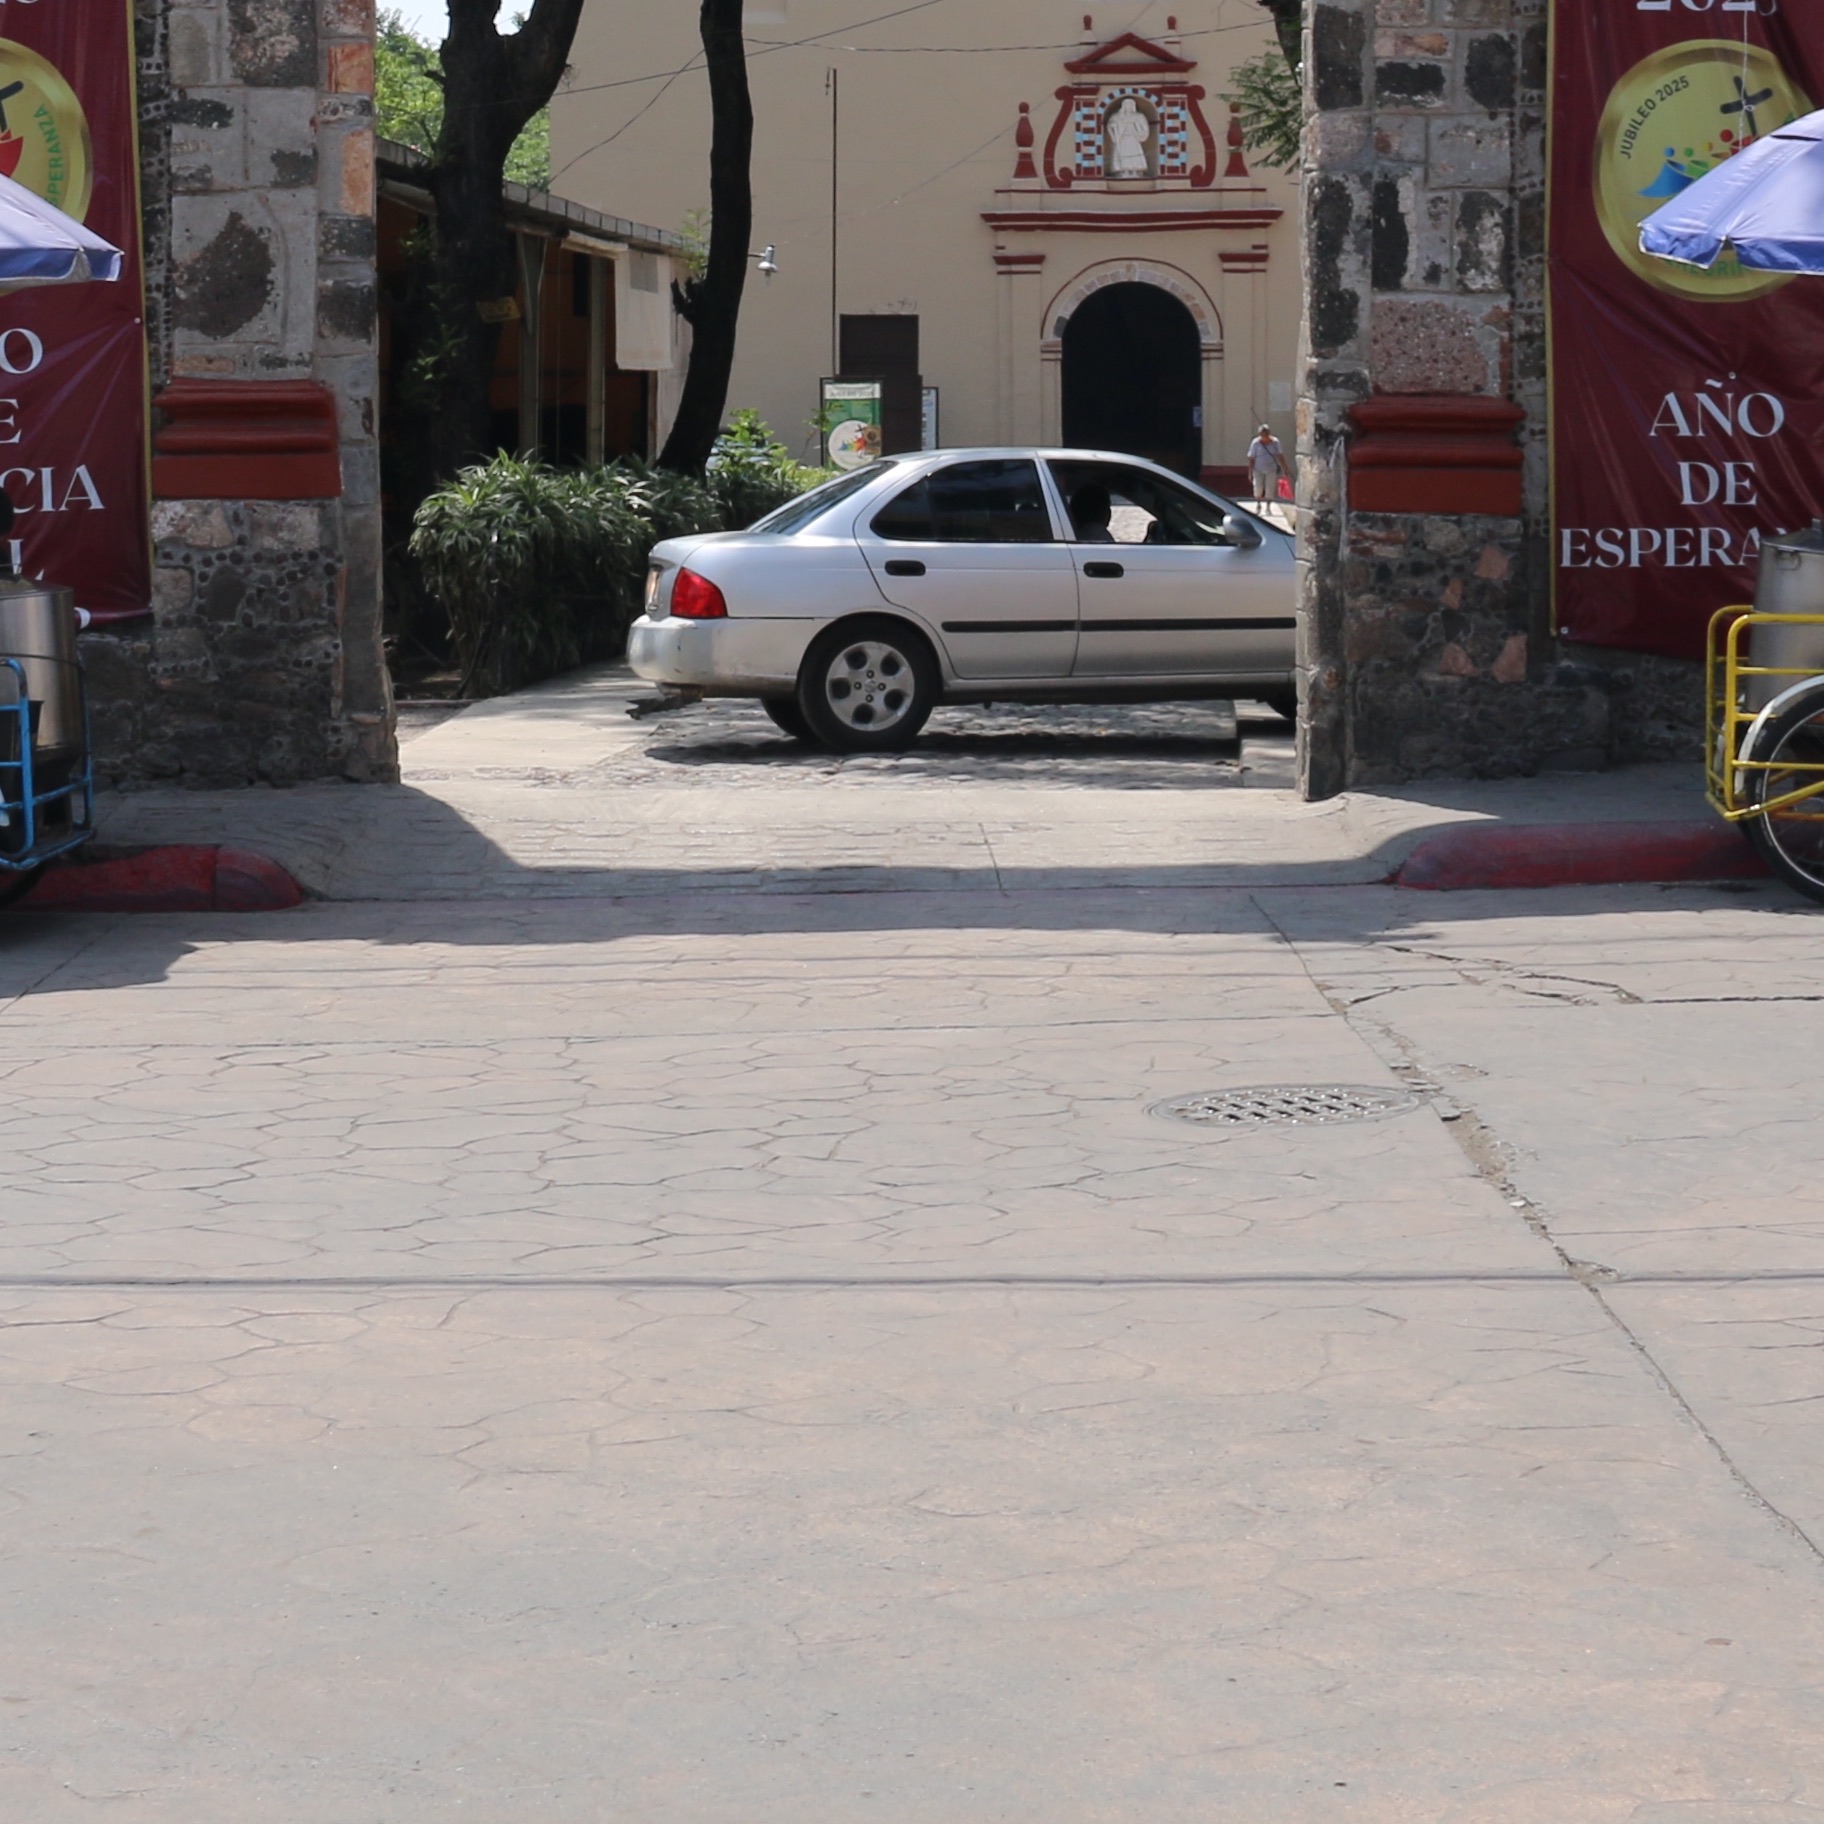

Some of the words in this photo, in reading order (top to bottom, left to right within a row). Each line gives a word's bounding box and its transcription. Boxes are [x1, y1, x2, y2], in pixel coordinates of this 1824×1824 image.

[1620, 98, 1657, 160] JUBILEO
[1655, 75, 1690, 102] 2025
[33, 103, 65, 207] SPERANZA
[1649, 378, 1785, 438] AÑO
[1676, 461, 1758, 506] DE
